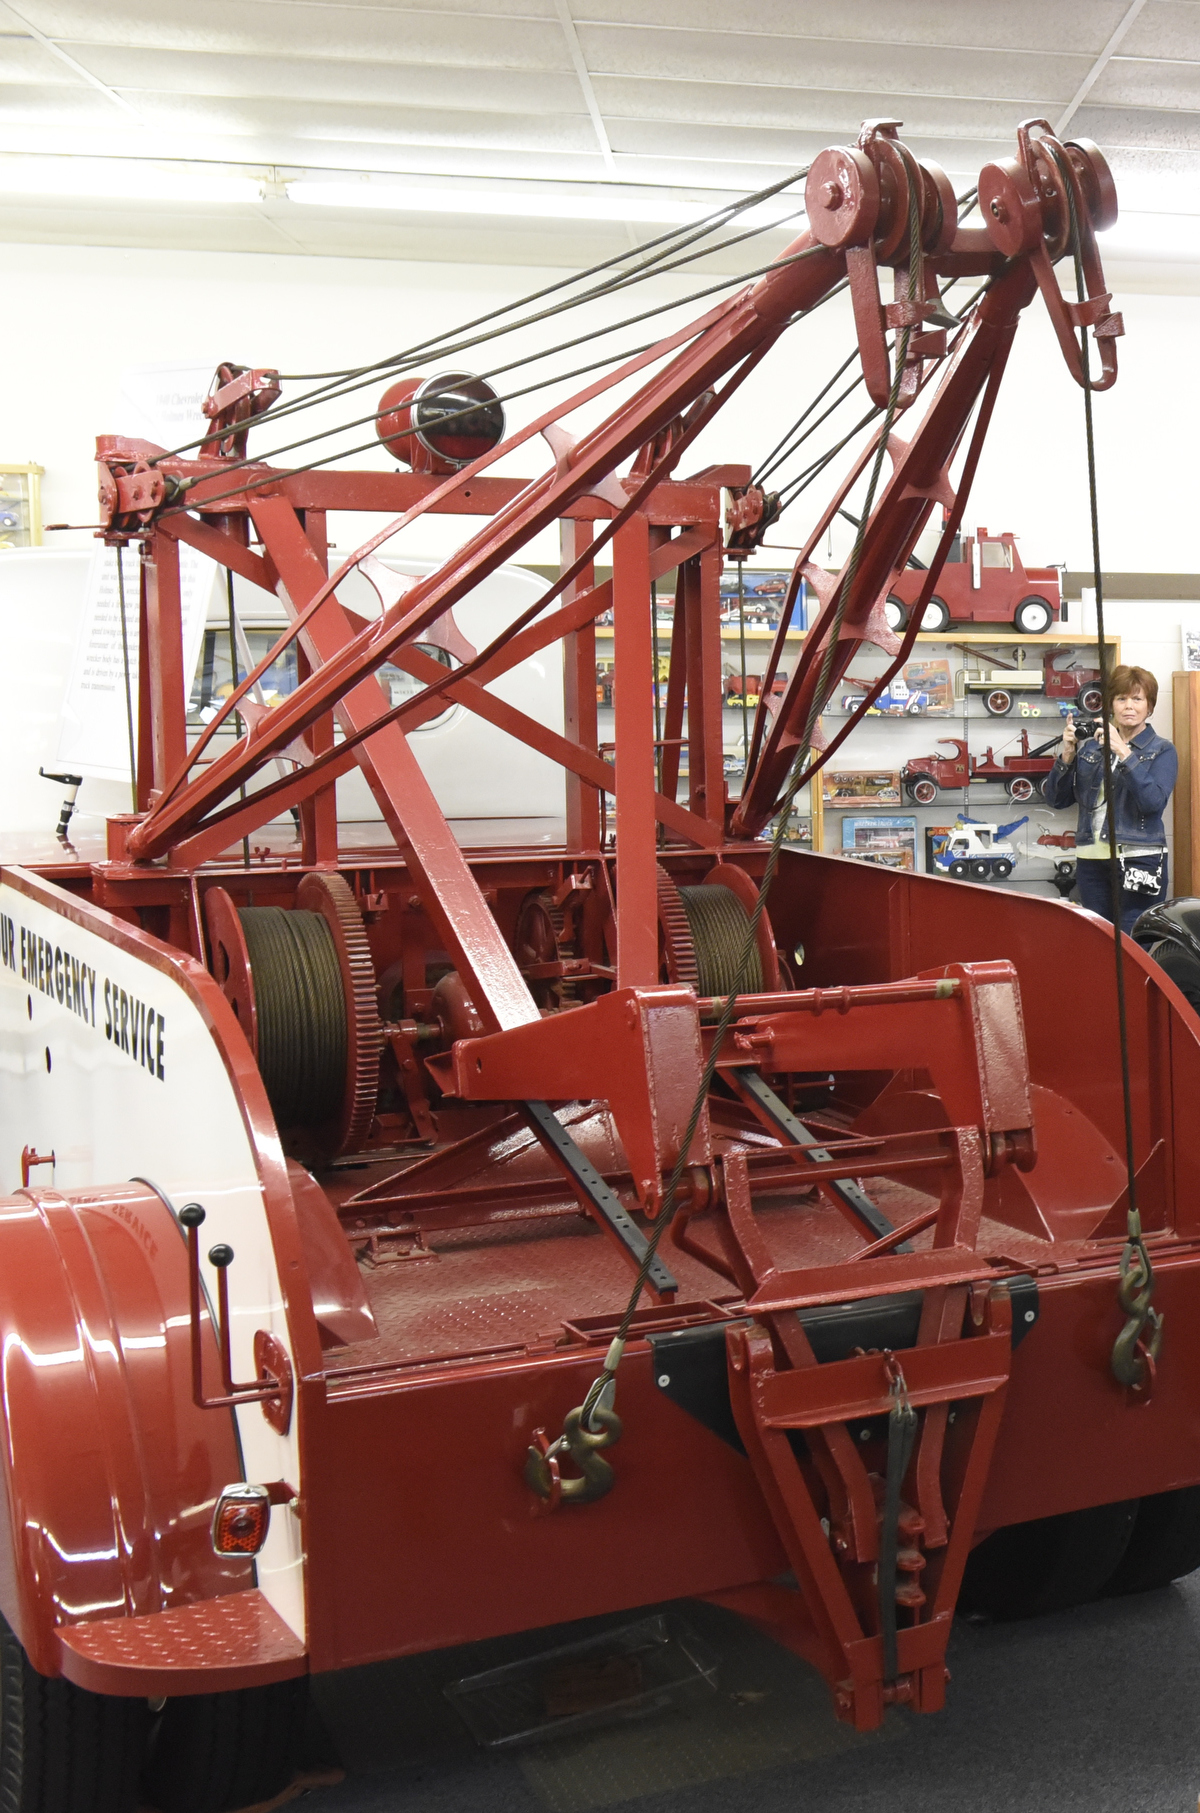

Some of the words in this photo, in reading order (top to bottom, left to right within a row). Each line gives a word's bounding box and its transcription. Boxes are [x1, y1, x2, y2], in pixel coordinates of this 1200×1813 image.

[0, 912, 16, 972] UR
[21, 926, 96, 1028] EMERGENCY
[104, 977, 165, 1082] SERVICE
